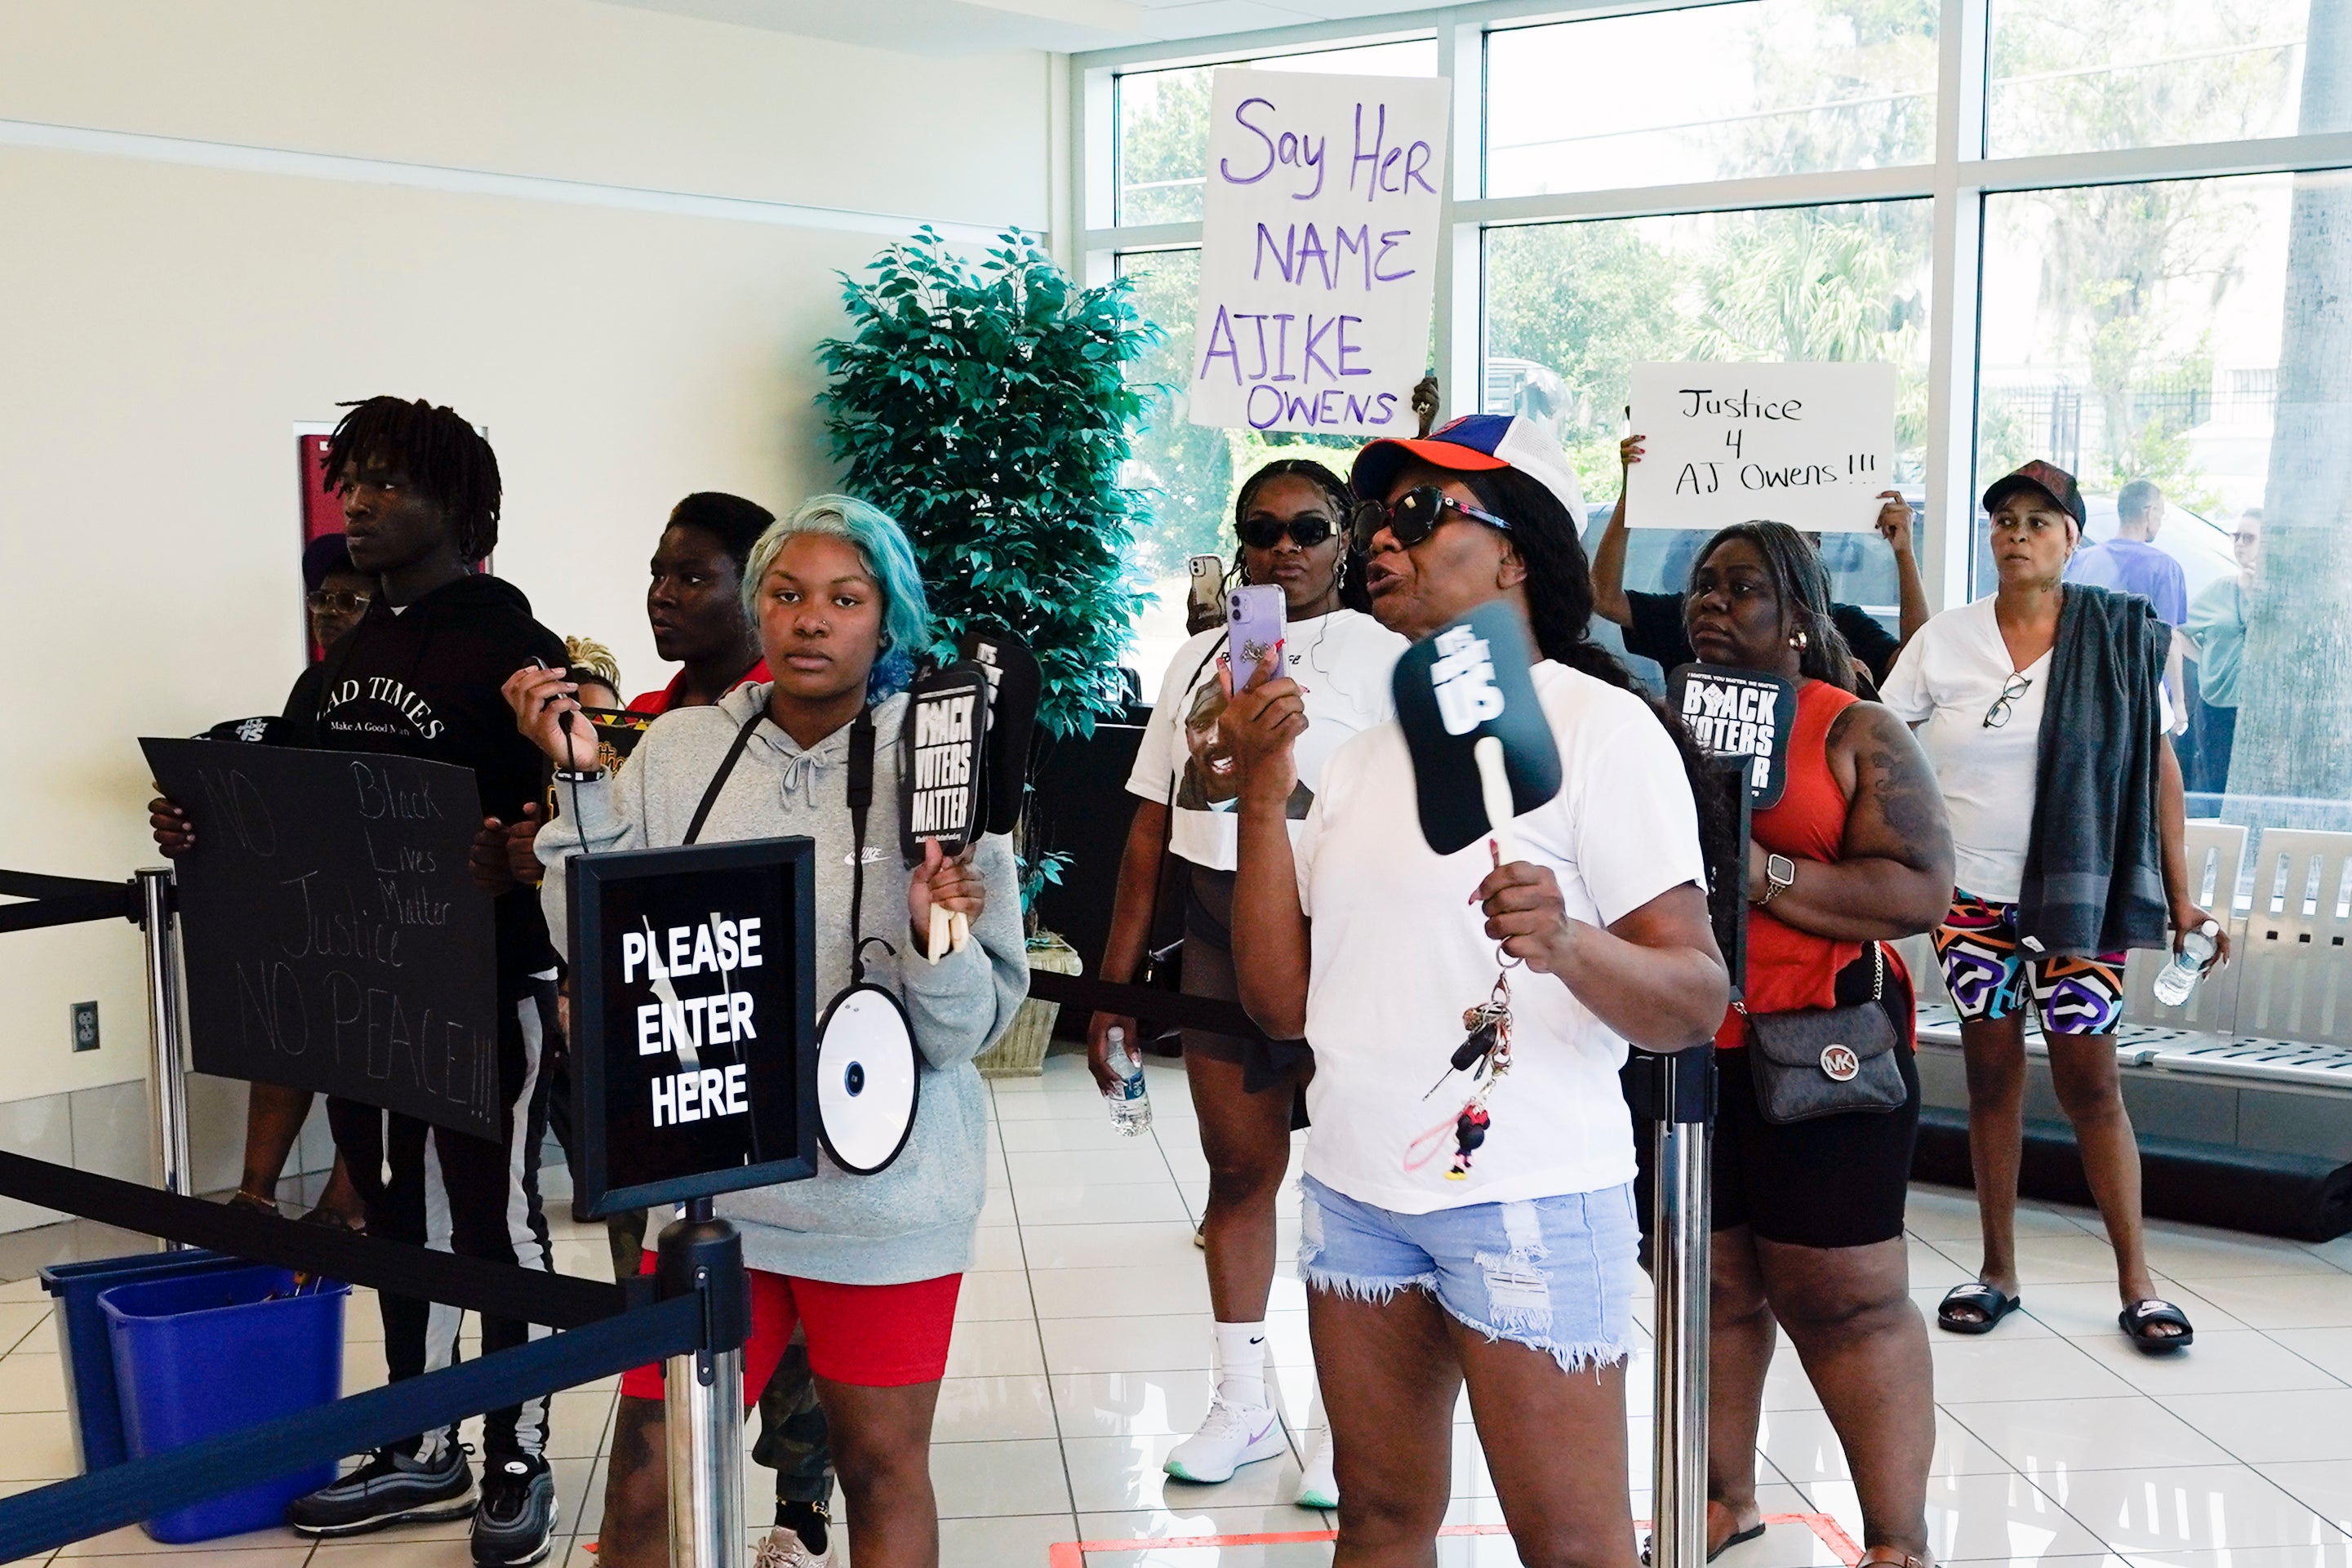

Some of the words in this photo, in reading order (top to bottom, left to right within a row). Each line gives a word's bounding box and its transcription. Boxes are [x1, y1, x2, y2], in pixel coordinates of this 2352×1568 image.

[1220, 96, 1325, 201] Say
[1253, 221, 1416, 291] NAME
[1199, 304, 1372, 386] AJIKE
[1247, 384, 1398, 429] OWENS
[1678, 389, 1803, 421] Justice
[1725, 429, 1743, 459] 4
[1675, 461, 1725, 495] AJ
[316, 678, 360, 722] AD
[368, 677, 445, 740] TIMES
[330, 721, 353, 731] Make
[354, 722, 362, 731] A
[364, 722, 388, 733] Good
[1682, 679, 1779, 726] BACK
[914, 741, 972, 790] VOTERS
[197, 766, 277, 857] NO
[911, 786, 970, 833] MATTER
[364, 824, 438, 874] Lives
[280, 869, 405, 967] Justice
[623, 917, 763, 984] PLEASE
[235, 957, 309, 1055] NO
[637, 990, 758, 1056] ENTER
[651, 1063, 749, 1128] HERE
